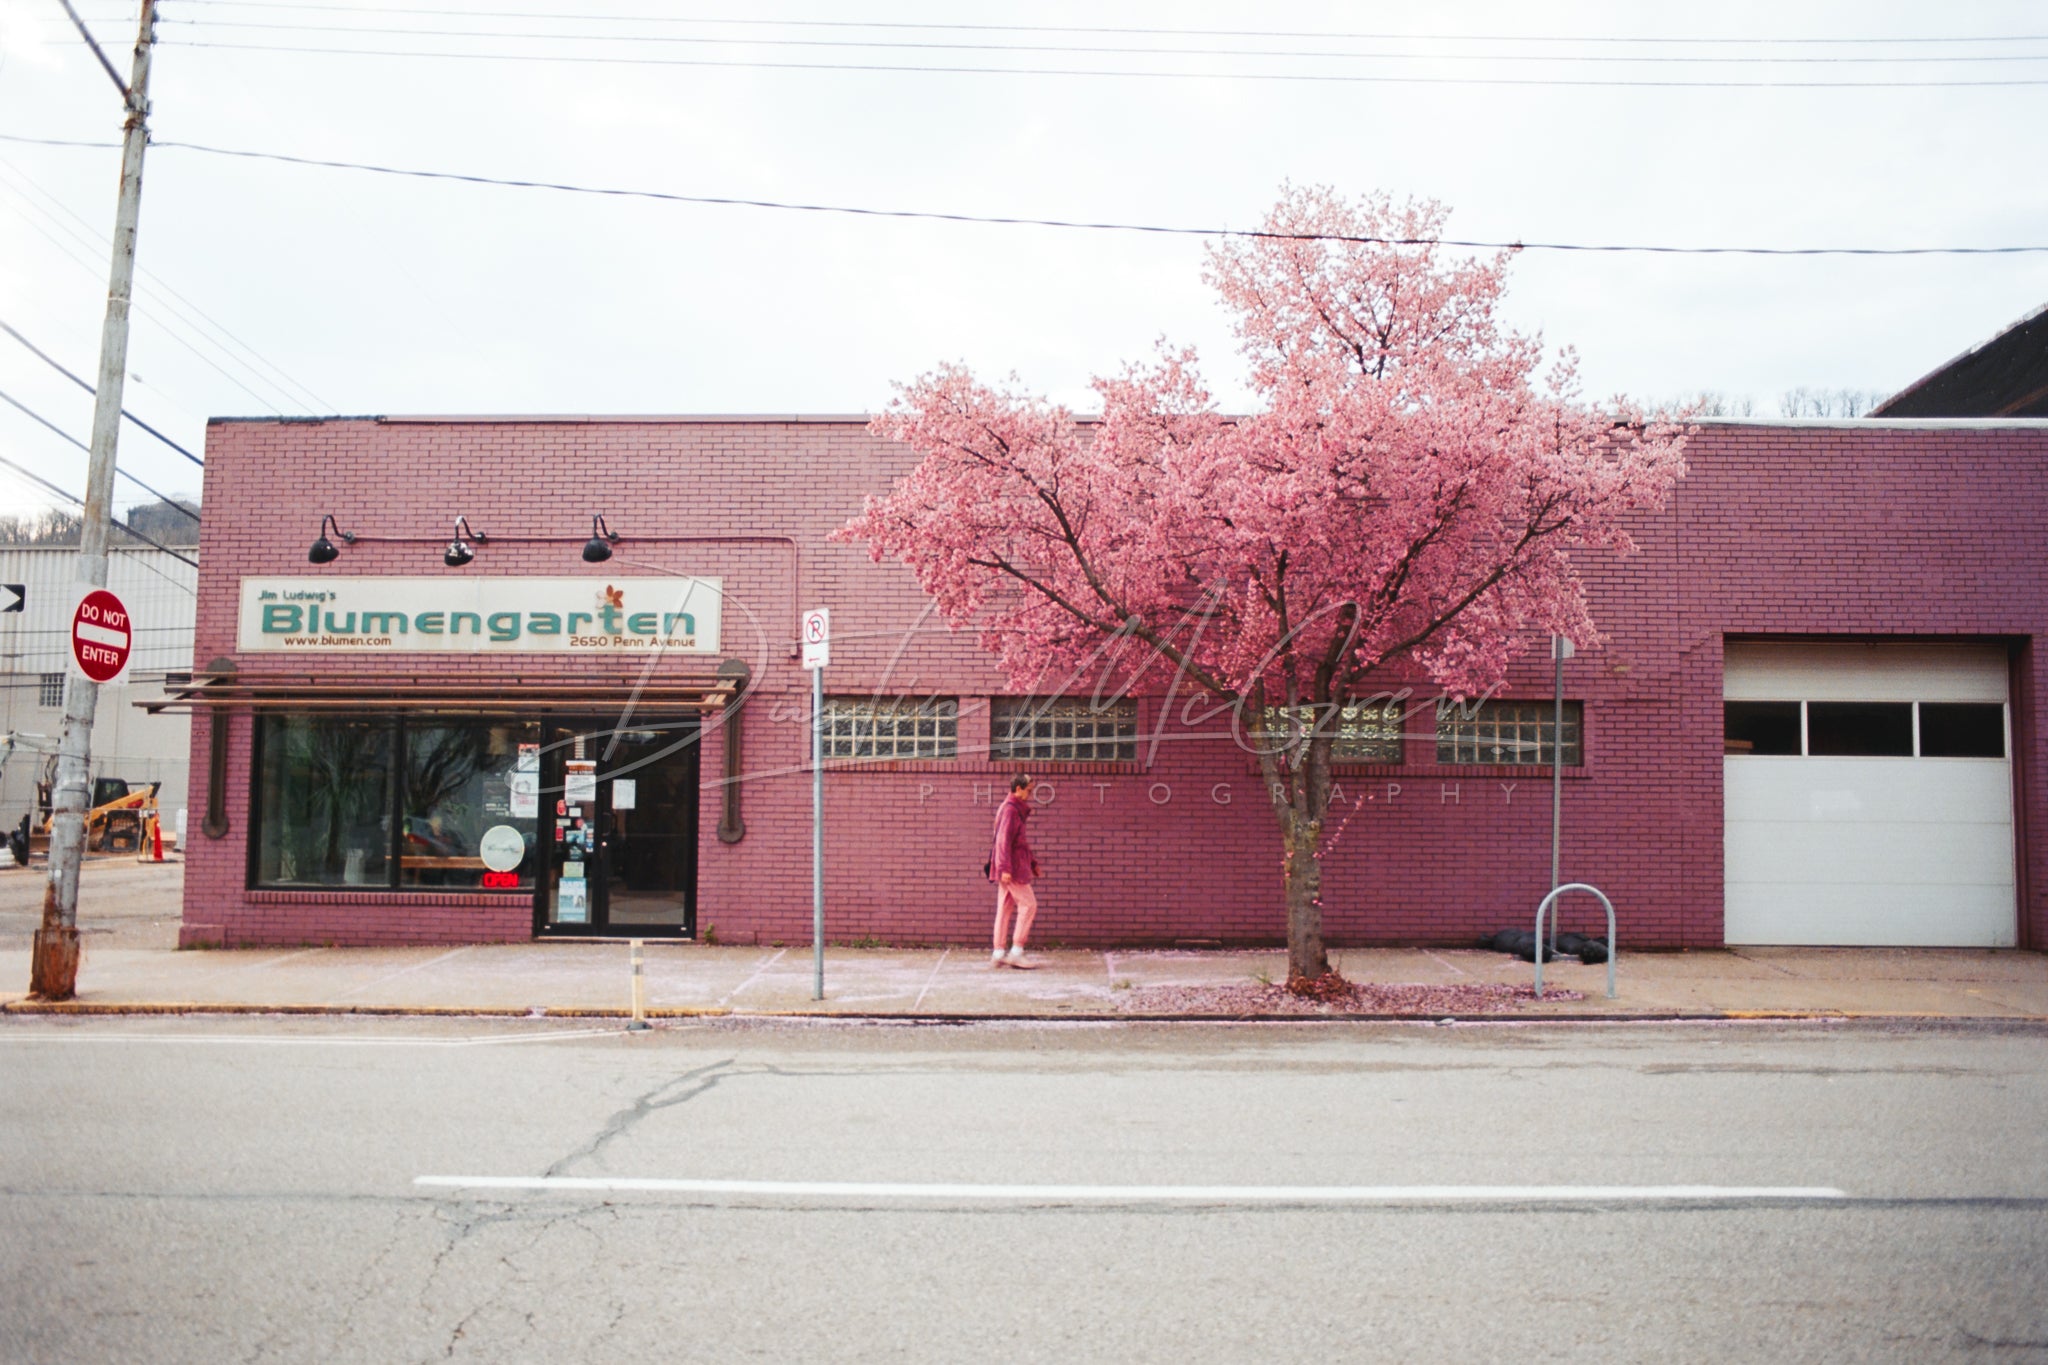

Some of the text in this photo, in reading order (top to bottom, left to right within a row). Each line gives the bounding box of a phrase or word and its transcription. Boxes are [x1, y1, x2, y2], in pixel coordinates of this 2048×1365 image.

[258, 589, 337, 602] Jim Ludwig's
[82, 603, 126, 627] DO NOT
[262, 604, 696, 642] Blumengarten
[284, 635, 392, 646] www.blumen.com
[570, 636, 696, 647] 2650 Penn Avenue
[82, 644, 119, 666] ENTER
[484, 872, 519, 888] OPEN
